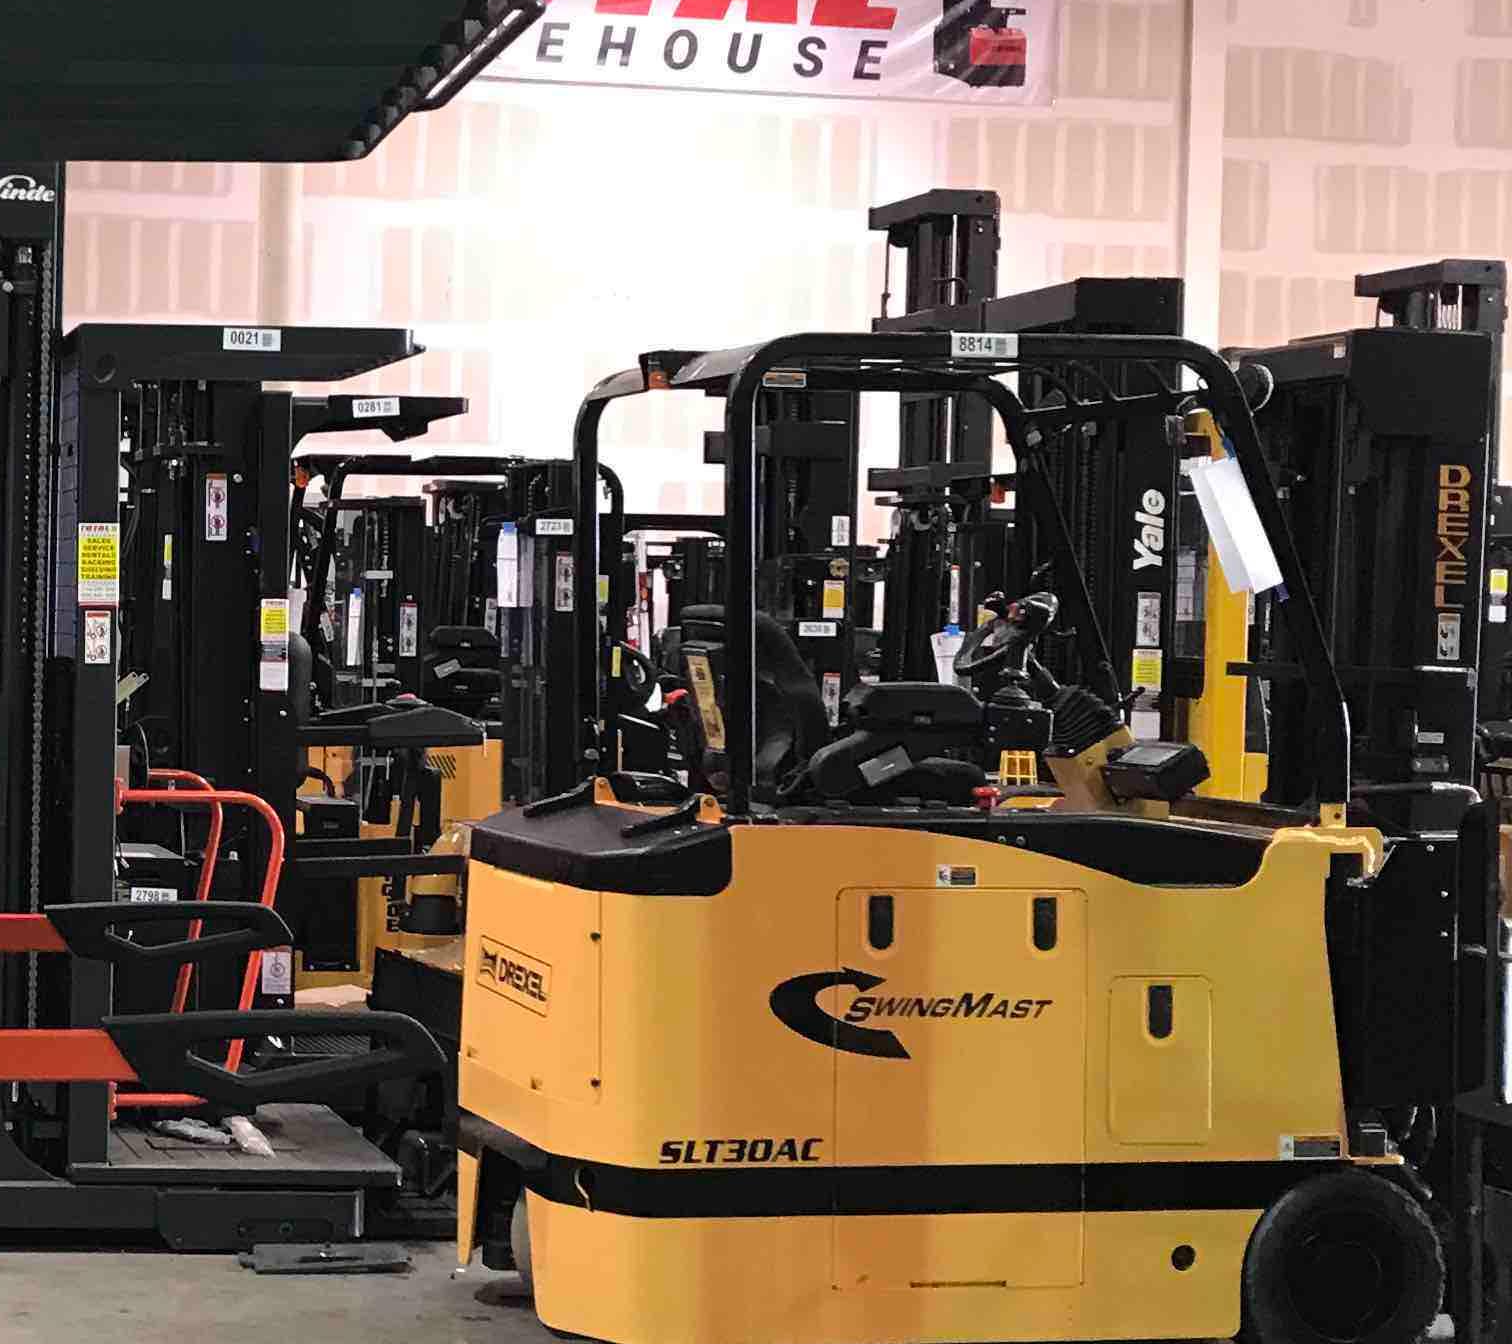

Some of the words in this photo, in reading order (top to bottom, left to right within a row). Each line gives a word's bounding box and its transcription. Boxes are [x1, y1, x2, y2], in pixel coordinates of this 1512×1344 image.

[535, 22, 889, 81] EHOUSE
[230, 331, 258, 345] 0021
[959, 337, 992, 352] 8814
[1133, 488, 1165, 570] Yale
[1434, 464, 1472, 608] DREXEL
[659, 1138, 824, 1164] SLT30AC
